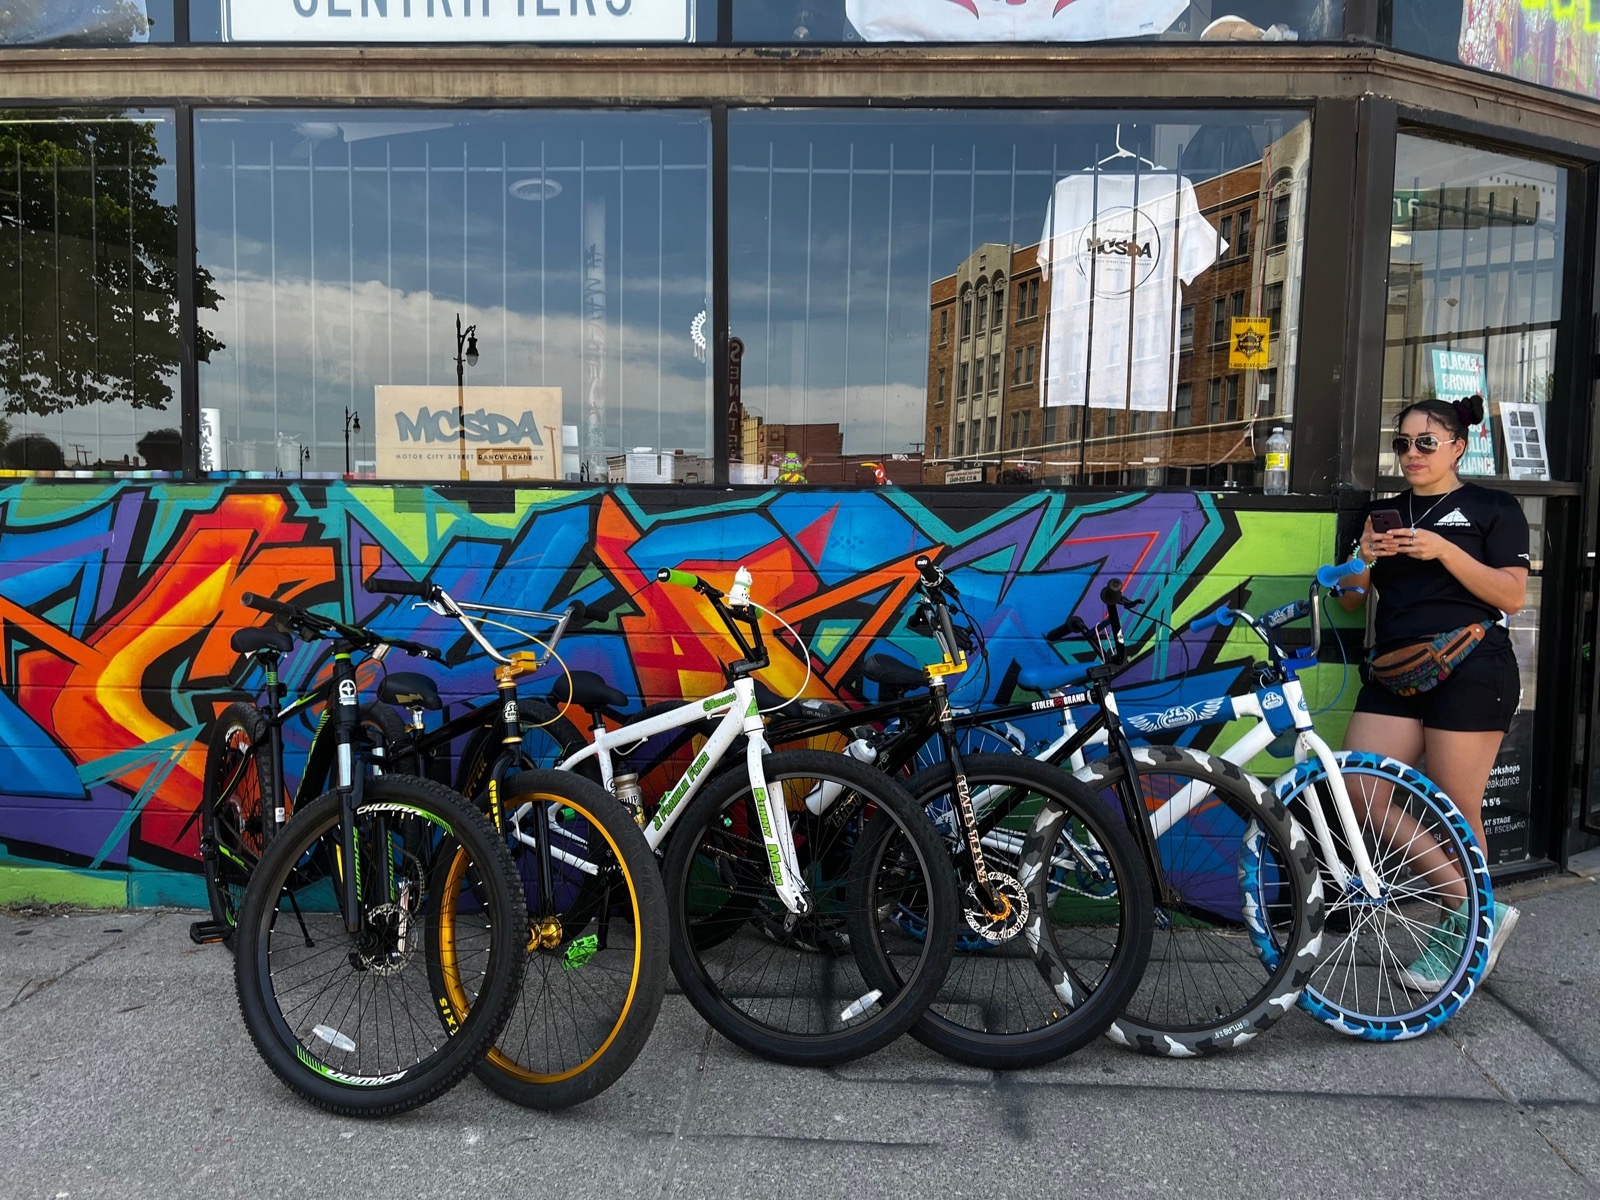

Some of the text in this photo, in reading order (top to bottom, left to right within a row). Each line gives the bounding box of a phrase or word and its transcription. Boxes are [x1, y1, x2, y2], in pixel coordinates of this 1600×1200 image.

[1442, 373, 1480, 392] BROWN
[395, 406, 544, 446] MCSDA
[1031, 692, 1086, 711] STOLEN BRAND
[686, 751, 710, 783] FLYER
[1490, 764, 1521, 777] orkshops
[1486, 775, 1520, 789] eakdance
[357, 802, 423, 815] CHWINN
[1492, 816, 1511, 826] STAGE
[1494, 820, 1526, 834] ESCENARIO
